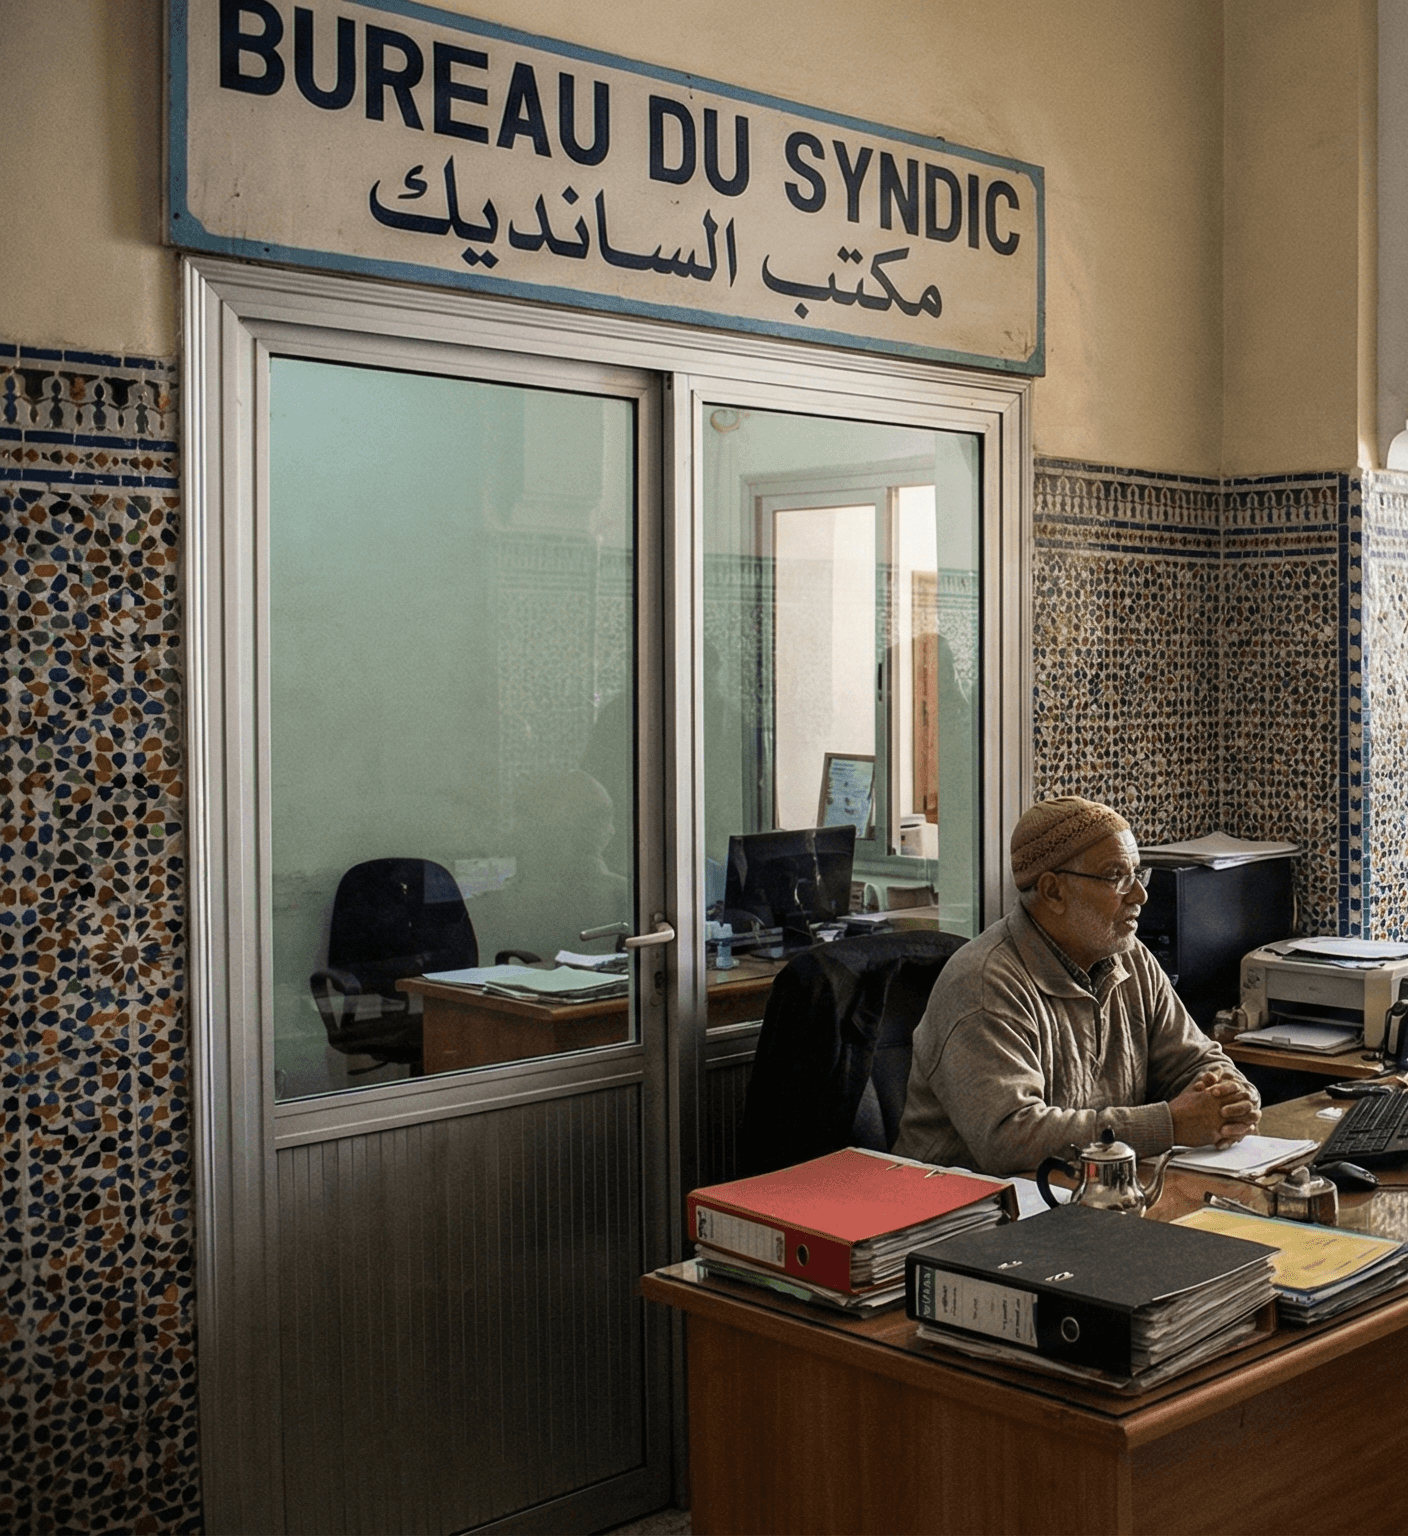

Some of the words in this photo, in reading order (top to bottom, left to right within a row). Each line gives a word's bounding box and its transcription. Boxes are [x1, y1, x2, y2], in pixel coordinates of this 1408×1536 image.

[219, 0, 610, 167] BUREAU
[649, 95, 750, 197] DU
[785, 132, 1020, 256] SYNDIC
[369, 155, 738, 288] السانديك
[761, 247, 943, 319] مكتب
